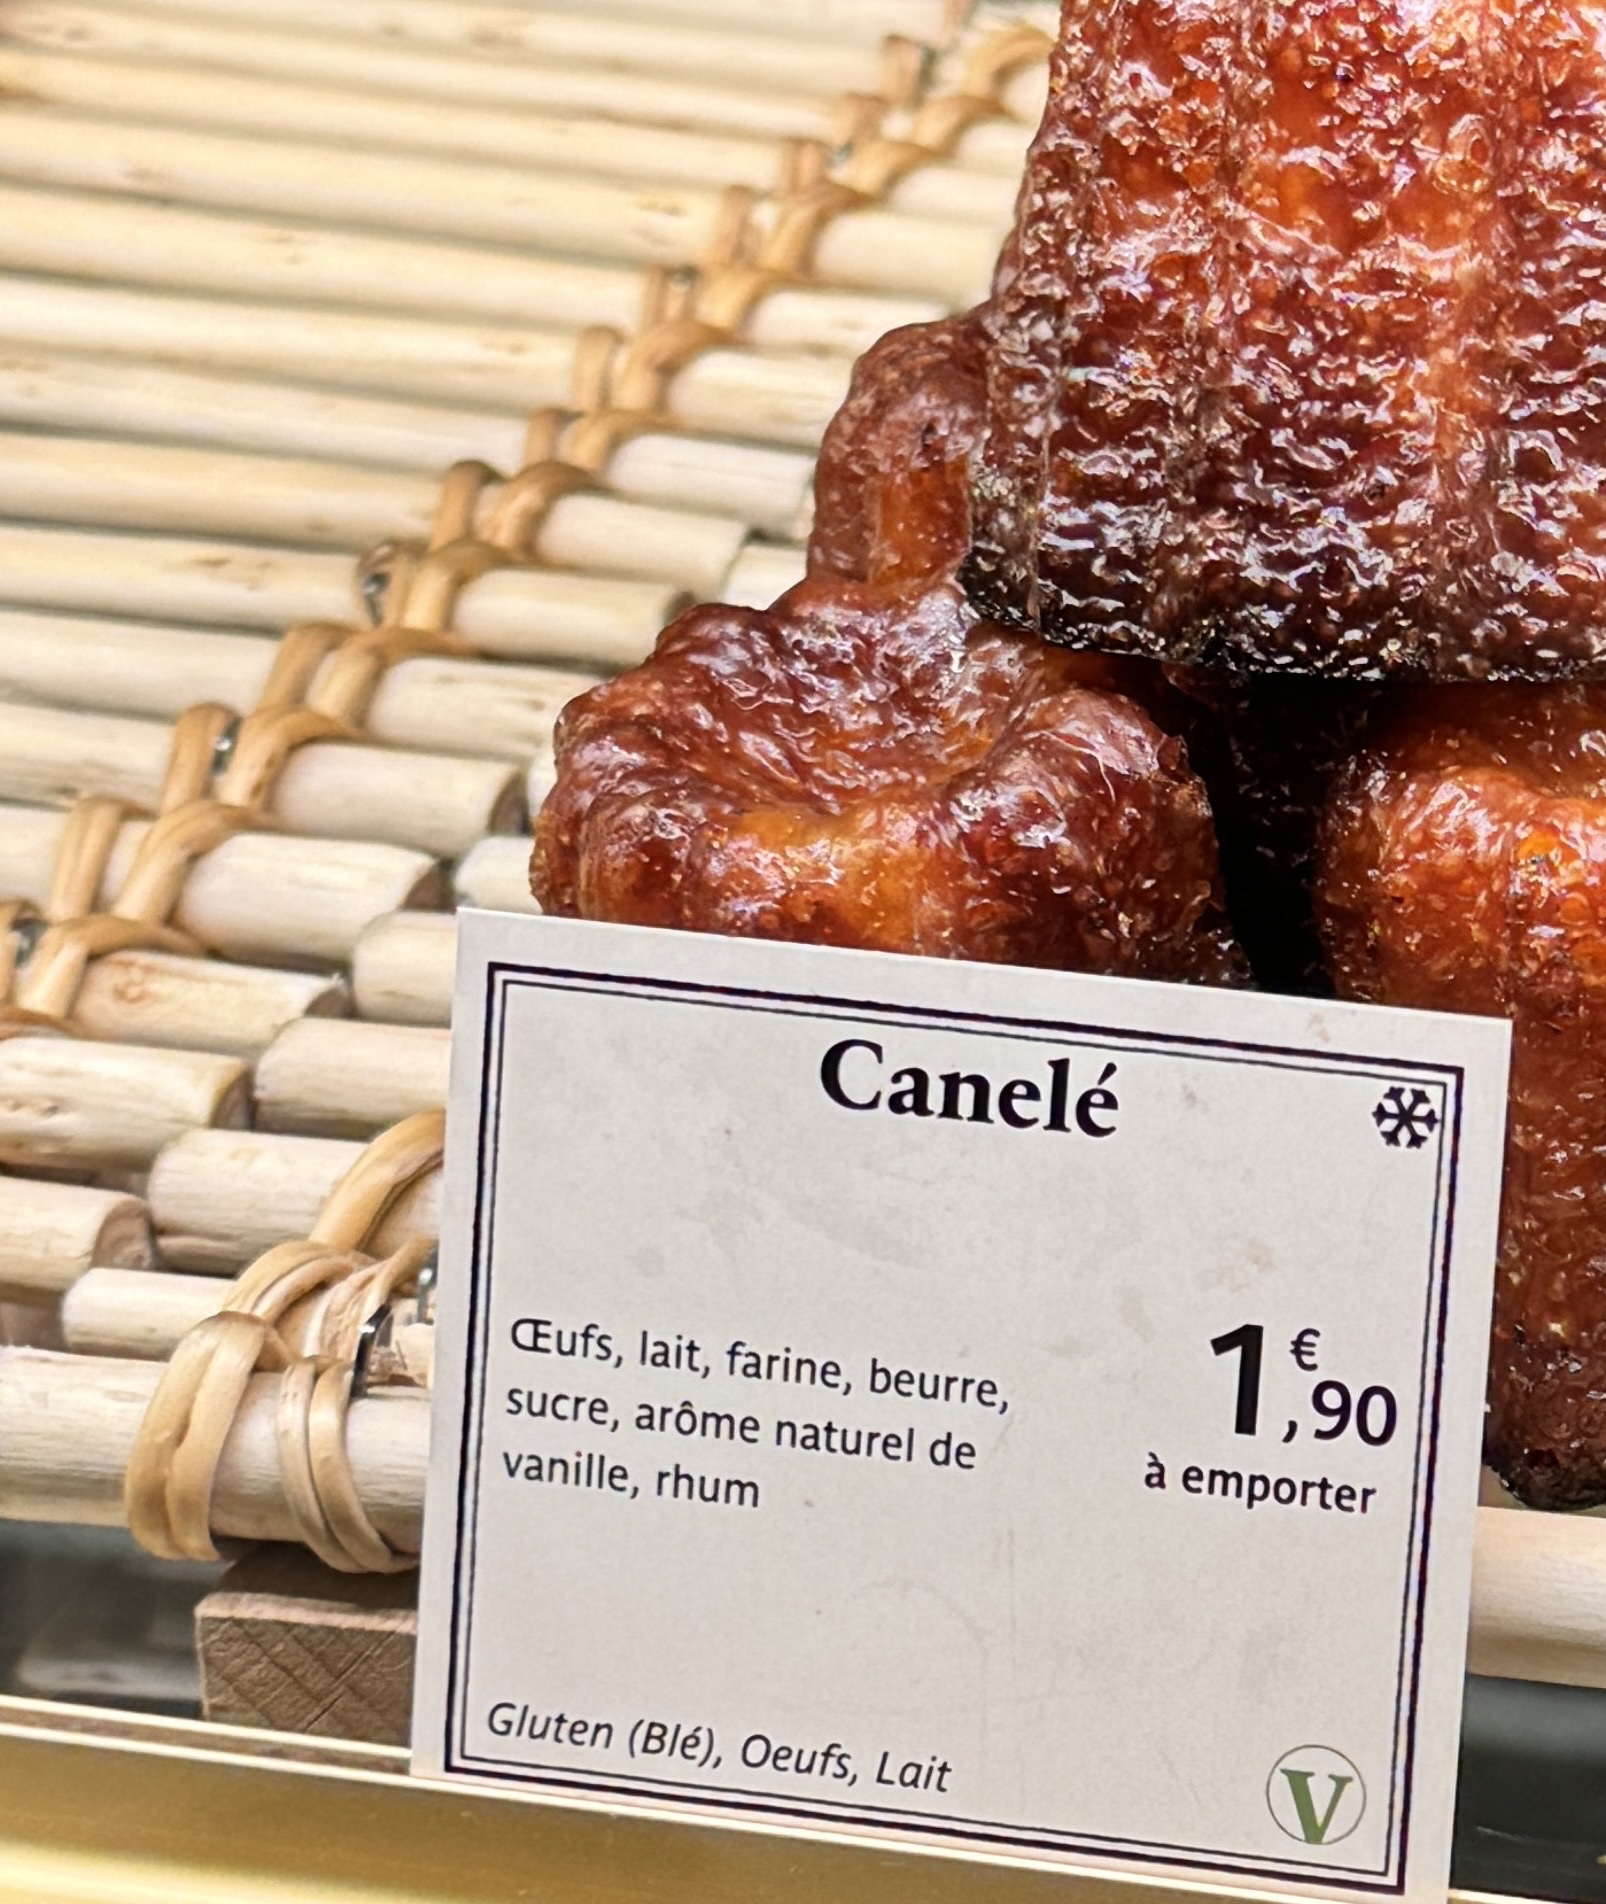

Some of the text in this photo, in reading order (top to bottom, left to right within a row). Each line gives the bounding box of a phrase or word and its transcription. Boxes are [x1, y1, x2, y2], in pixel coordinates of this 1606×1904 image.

[819, 1037, 1120, 1139] Canelé
[509, 1317, 1009, 1416] Œufs, lait, farine, beurre,
[505, 1387, 977, 1471] sucre, arôme naturel de
[501, 1450, 760, 1509] vanille, rhum
[1143, 1450, 1378, 1515] à emporter
[487, 1701, 953, 1794] Gluten (Blé), Oeufs, Lait
[1279, 1767, 1355, 1846] V
